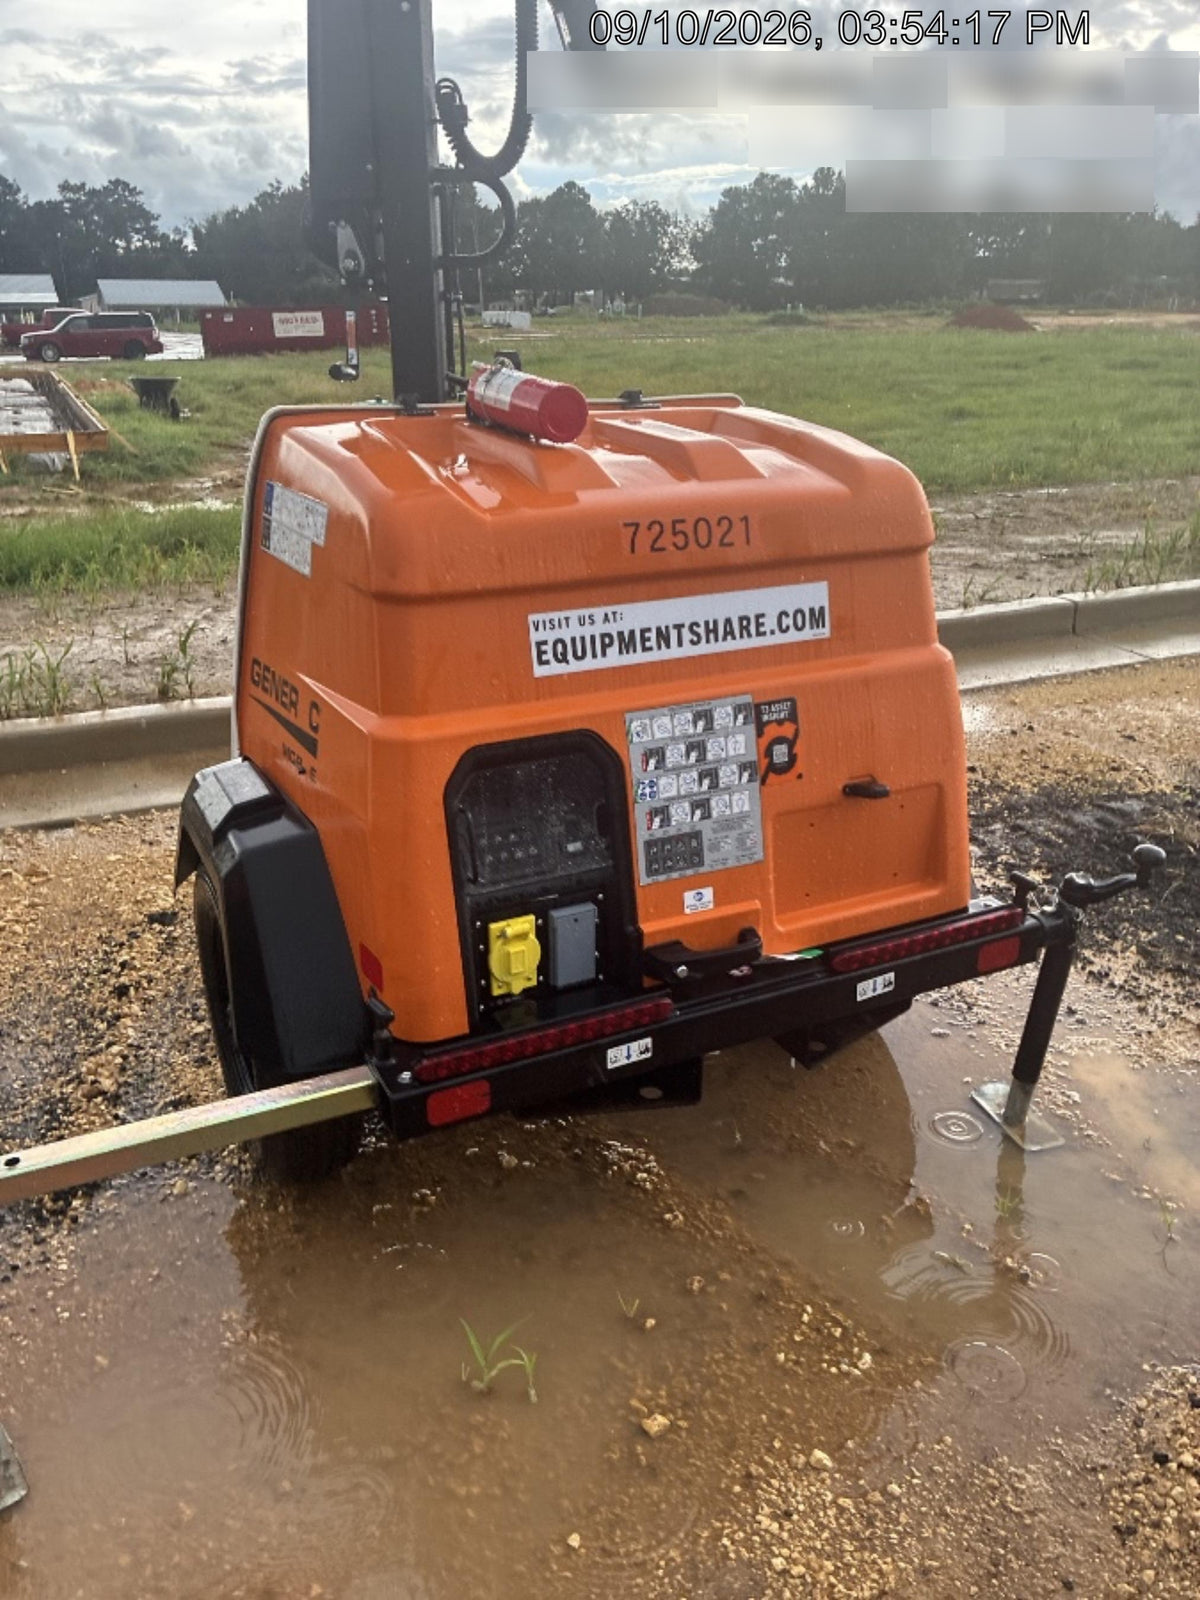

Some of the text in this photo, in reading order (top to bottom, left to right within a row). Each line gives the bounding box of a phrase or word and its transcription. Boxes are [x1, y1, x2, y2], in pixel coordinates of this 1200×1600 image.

[622, 515, 751, 554] 725021
[533, 610, 624, 632] VISIT US AT:
[535, 605, 826, 666] EQUIPMENTSHARE.COM
